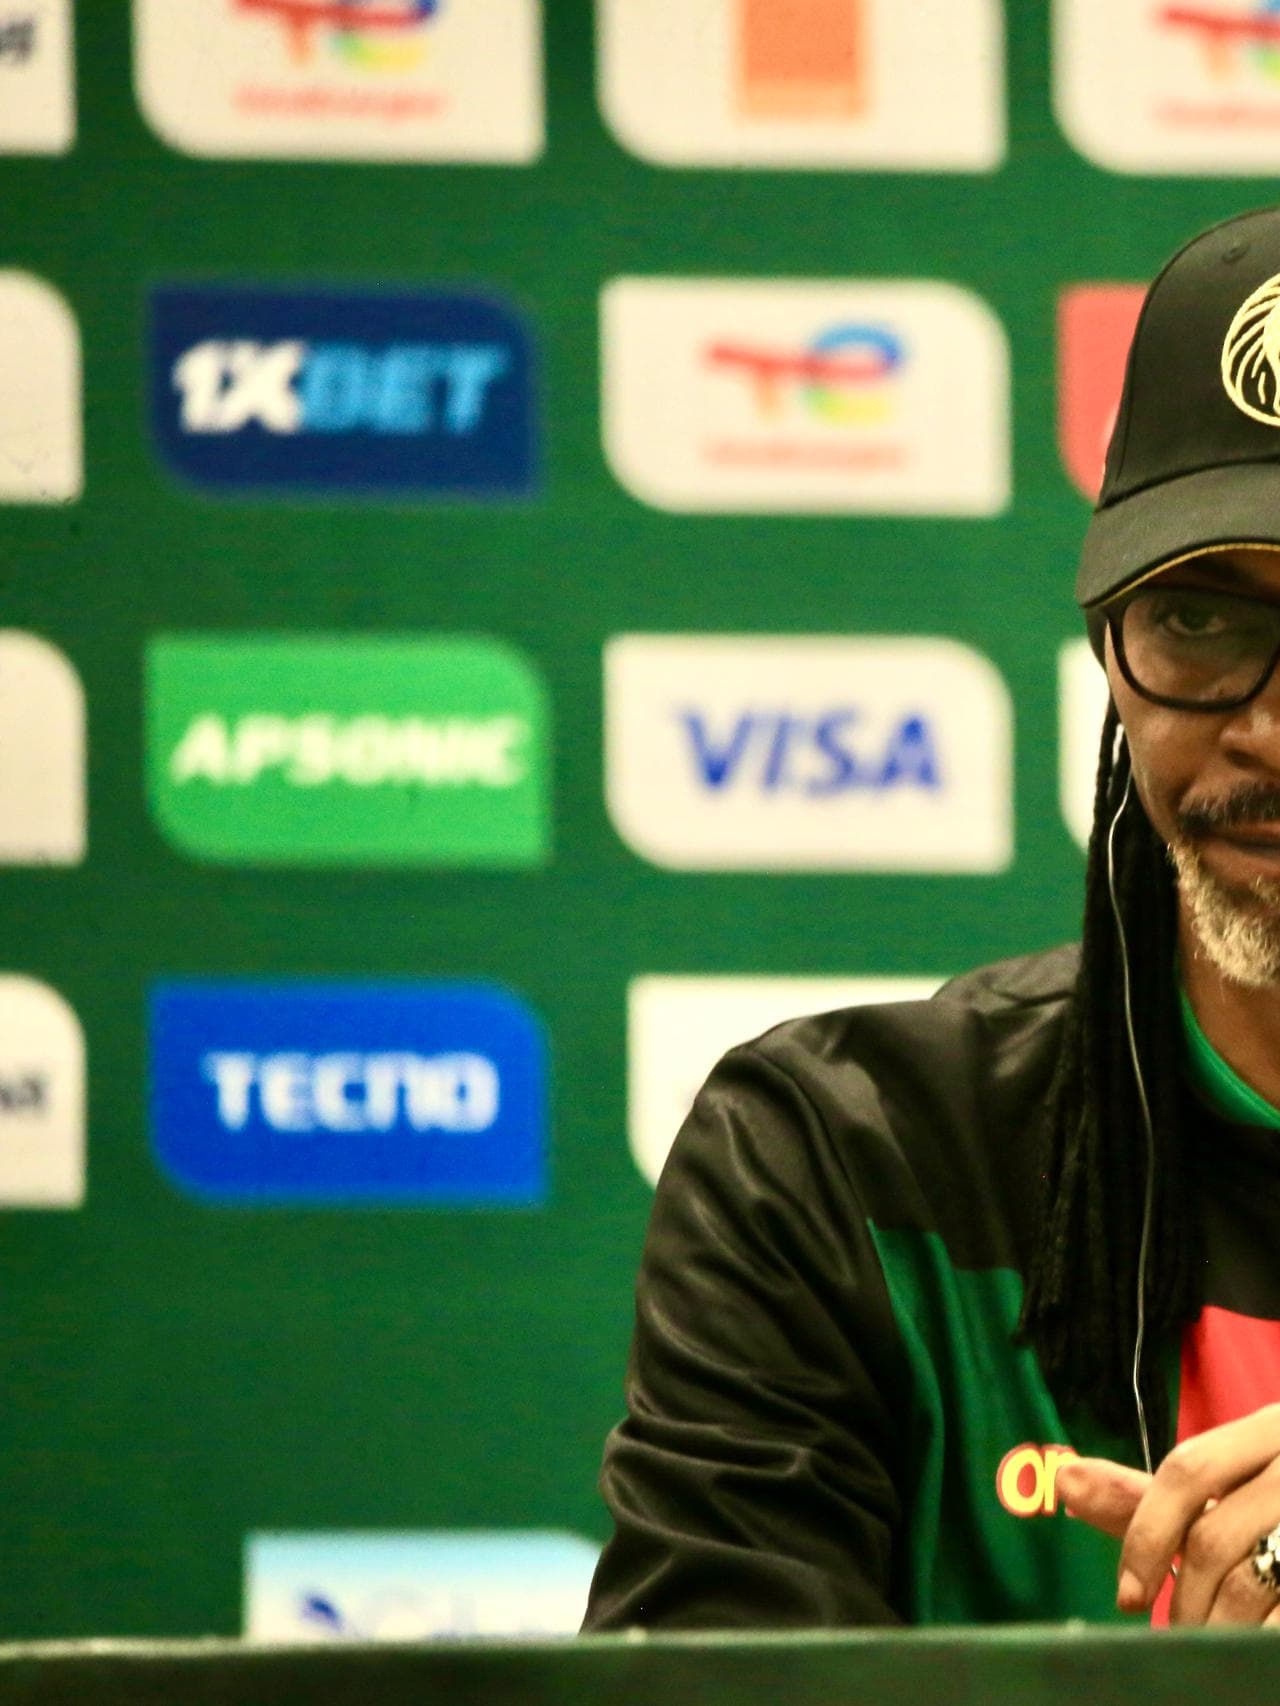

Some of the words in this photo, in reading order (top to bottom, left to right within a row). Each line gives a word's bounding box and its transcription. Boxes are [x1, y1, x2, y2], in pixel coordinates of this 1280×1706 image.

[172, 339, 508, 435] 1XBET
[680, 702, 946, 796] VISA
[203, 1051, 500, 1133] TECNO
